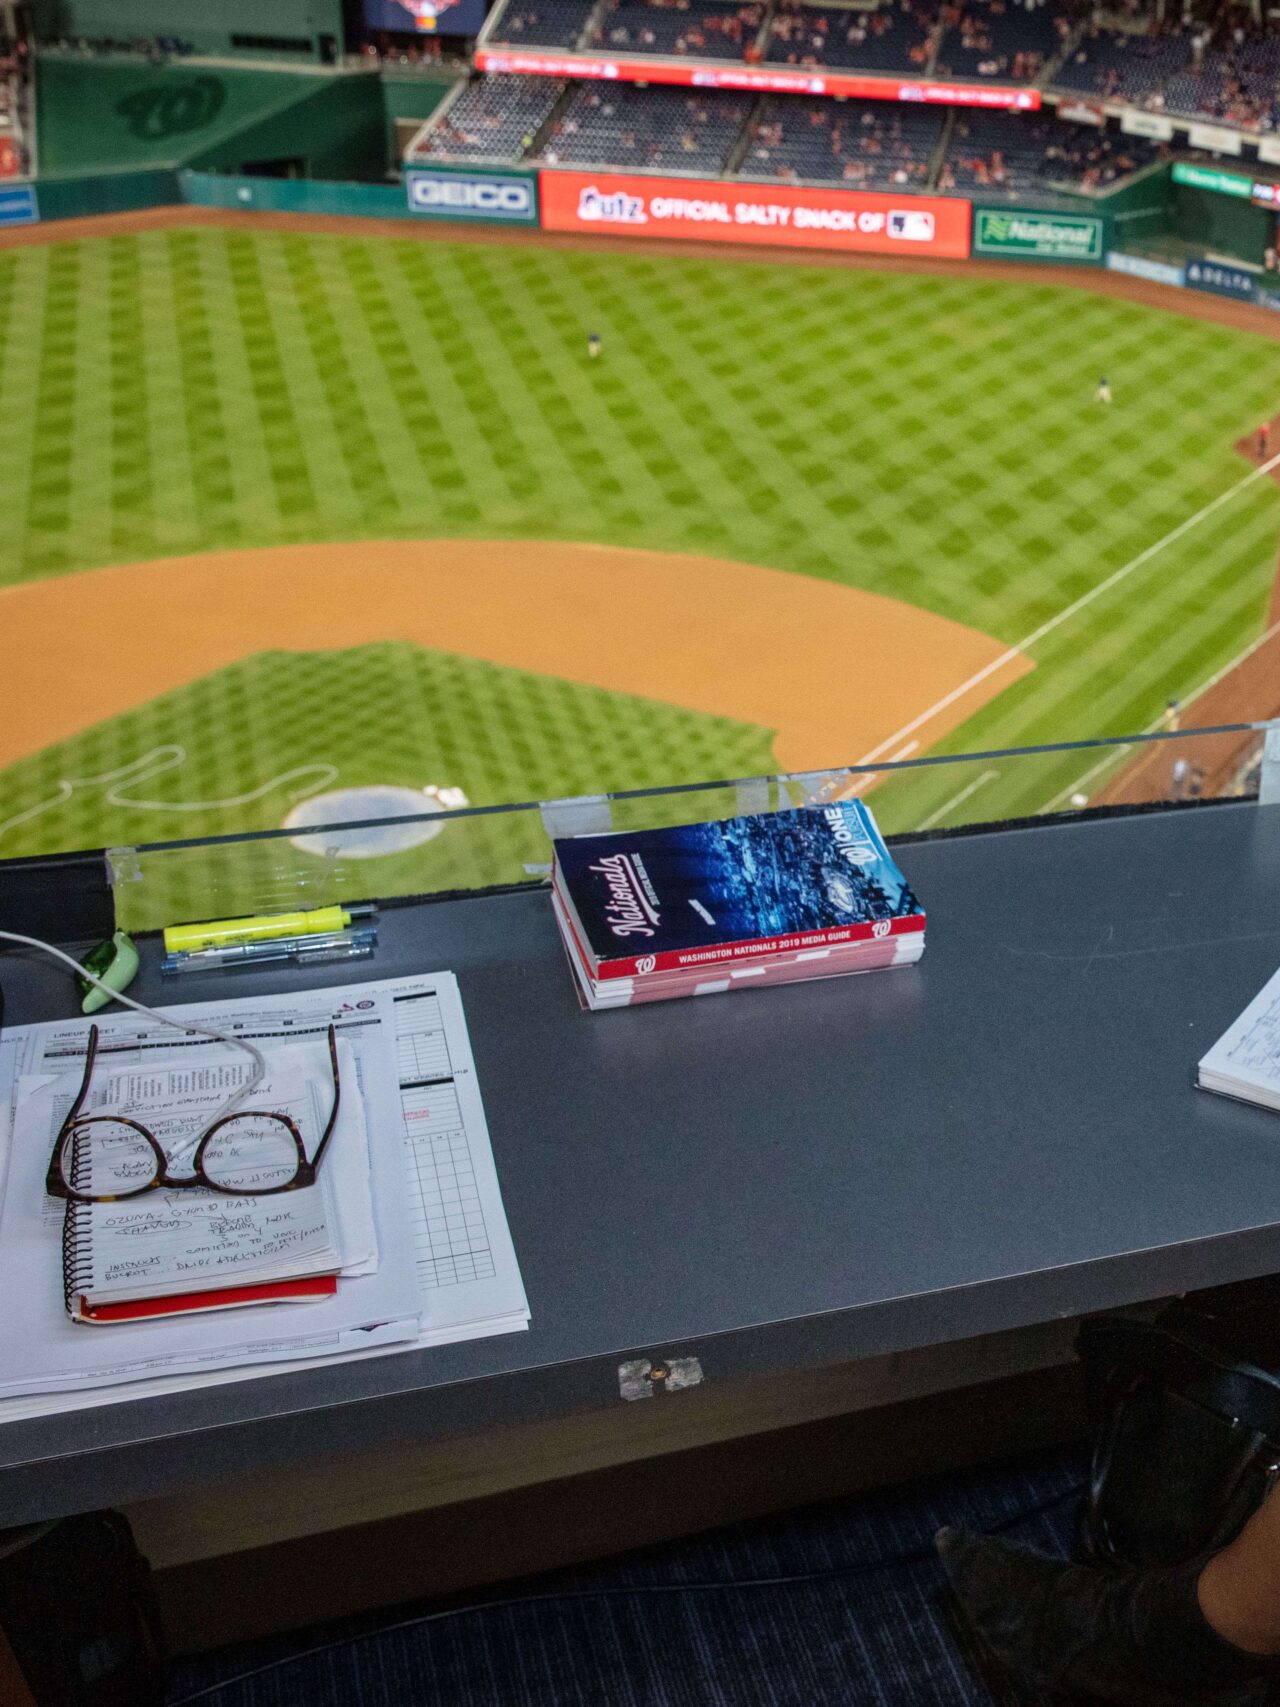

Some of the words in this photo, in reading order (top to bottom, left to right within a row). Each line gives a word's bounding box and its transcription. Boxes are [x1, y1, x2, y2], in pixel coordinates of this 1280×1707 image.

[415, 180, 528, 211] GEICO
[650, 197, 732, 223] OFFICIAL
[735, 203, 791, 226] SALTY
[793, 207, 856, 231] SNACK
[858, 212, 885, 233] OF
[1009, 220, 1093, 244] National
[1200, 264, 1252, 291] DELTA
[824, 807, 852, 841] ONE
[589, 853, 656, 937] Nationals
[679, 949, 732, 964] WASHINGTON
[734, 942, 777, 956] NATIONALS
[779, 938, 800, 949] 2019
[801, 934, 826, 946] MEDIA
[827, 930, 851, 942] GUIDE
[54, 1030, 86, 1039] LINEUP
